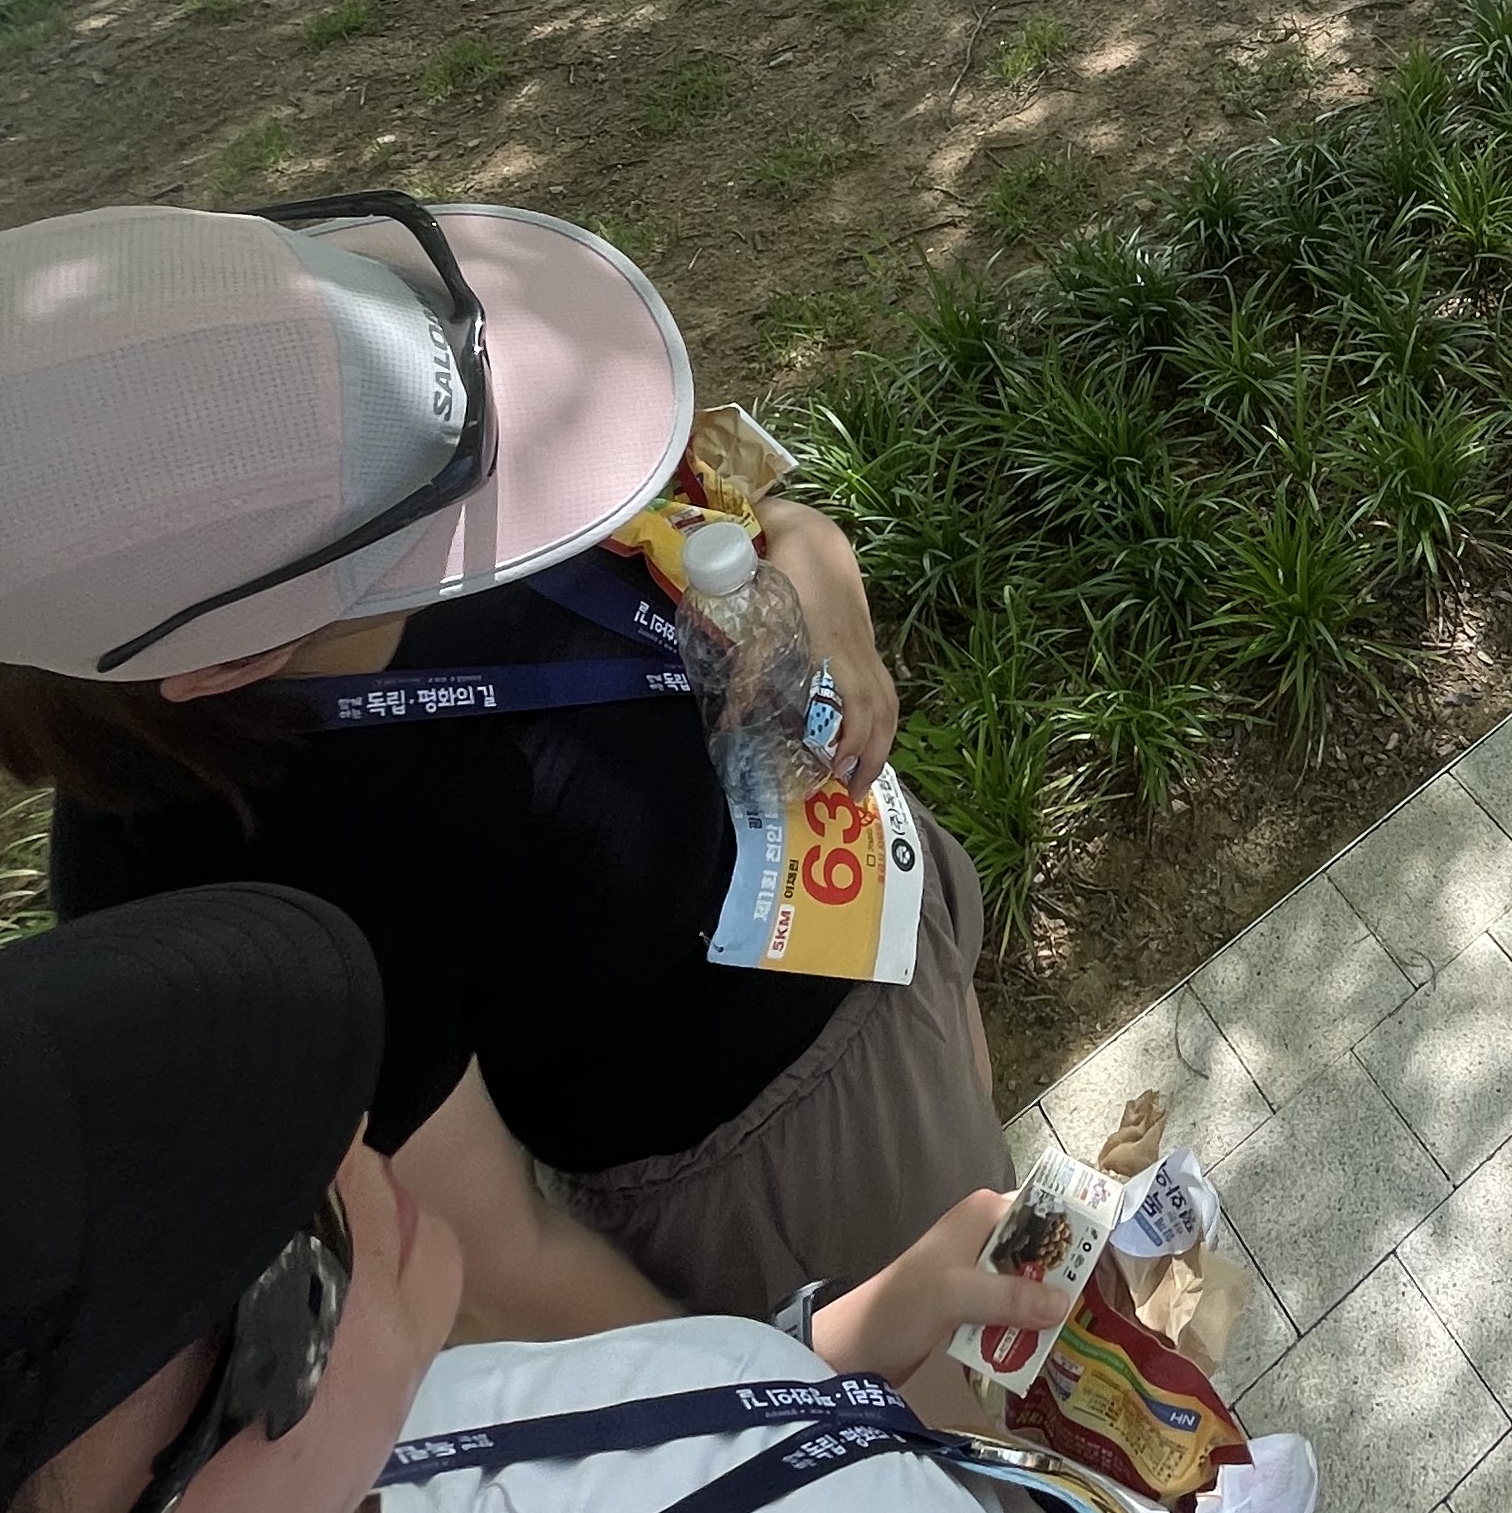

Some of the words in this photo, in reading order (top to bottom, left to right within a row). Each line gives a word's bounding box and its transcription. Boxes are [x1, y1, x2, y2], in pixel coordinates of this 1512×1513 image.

[633, 600, 650, 626] 길
[477, 684, 497, 707] 길
[765, 824, 782, 863] 천안
[772, 910, 791, 952] 5KM
[736, 1388, 768, 1410] 길
[1169, 1411, 1196, 1427] NH
